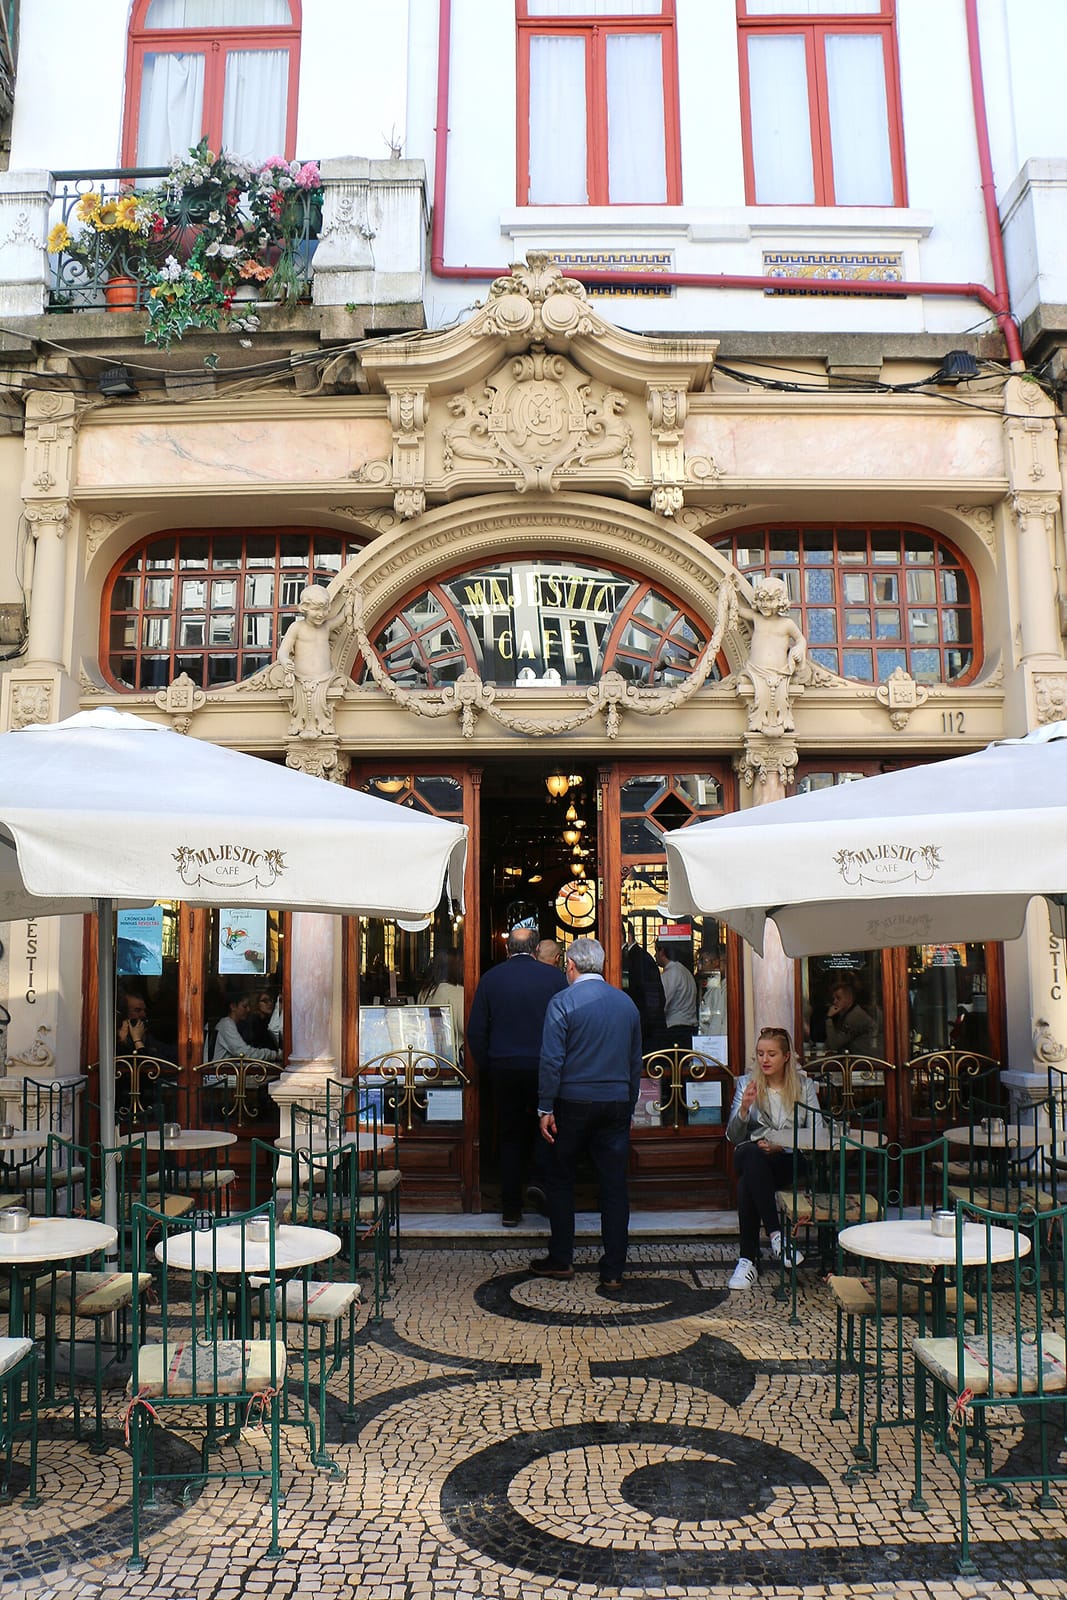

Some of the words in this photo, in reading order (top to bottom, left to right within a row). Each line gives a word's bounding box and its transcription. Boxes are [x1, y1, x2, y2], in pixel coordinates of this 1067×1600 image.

[464, 572, 616, 619] MAJESTIC
[498, 619, 582, 660] CAFÉ
[942, 711, 966, 734] 112
[195, 844, 264, 868] MAJESTIC
[854, 844, 921, 868] MAJESTIC
[26, 917, 38, 1004] ESTIC
